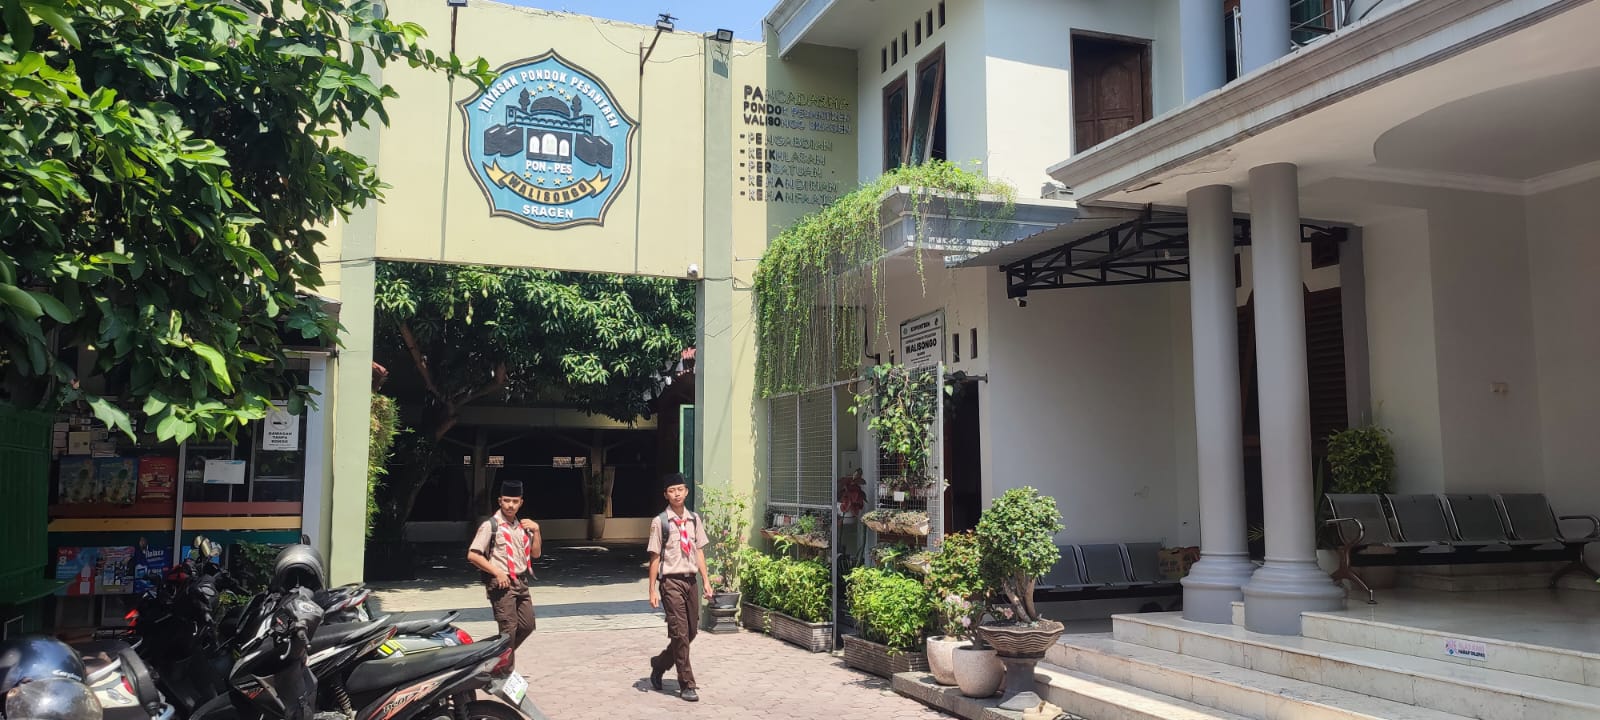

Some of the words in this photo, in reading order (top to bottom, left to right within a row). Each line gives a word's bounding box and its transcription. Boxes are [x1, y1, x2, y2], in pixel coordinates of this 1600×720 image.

[478, 75, 519, 113] YAYASAN
[521, 69, 567, 83] PONDOK
[570, 76, 619, 128] PESANTREN
[743, 101, 787, 115] PONDOK
[525, 160, 546, 172] PON
[554, 161, 573, 174] PES
[508, 175, 587, 202] WALISONGO
[522, 204, 574, 219] SRAGEN
[906, 338, 937, 354] WALISONGO
